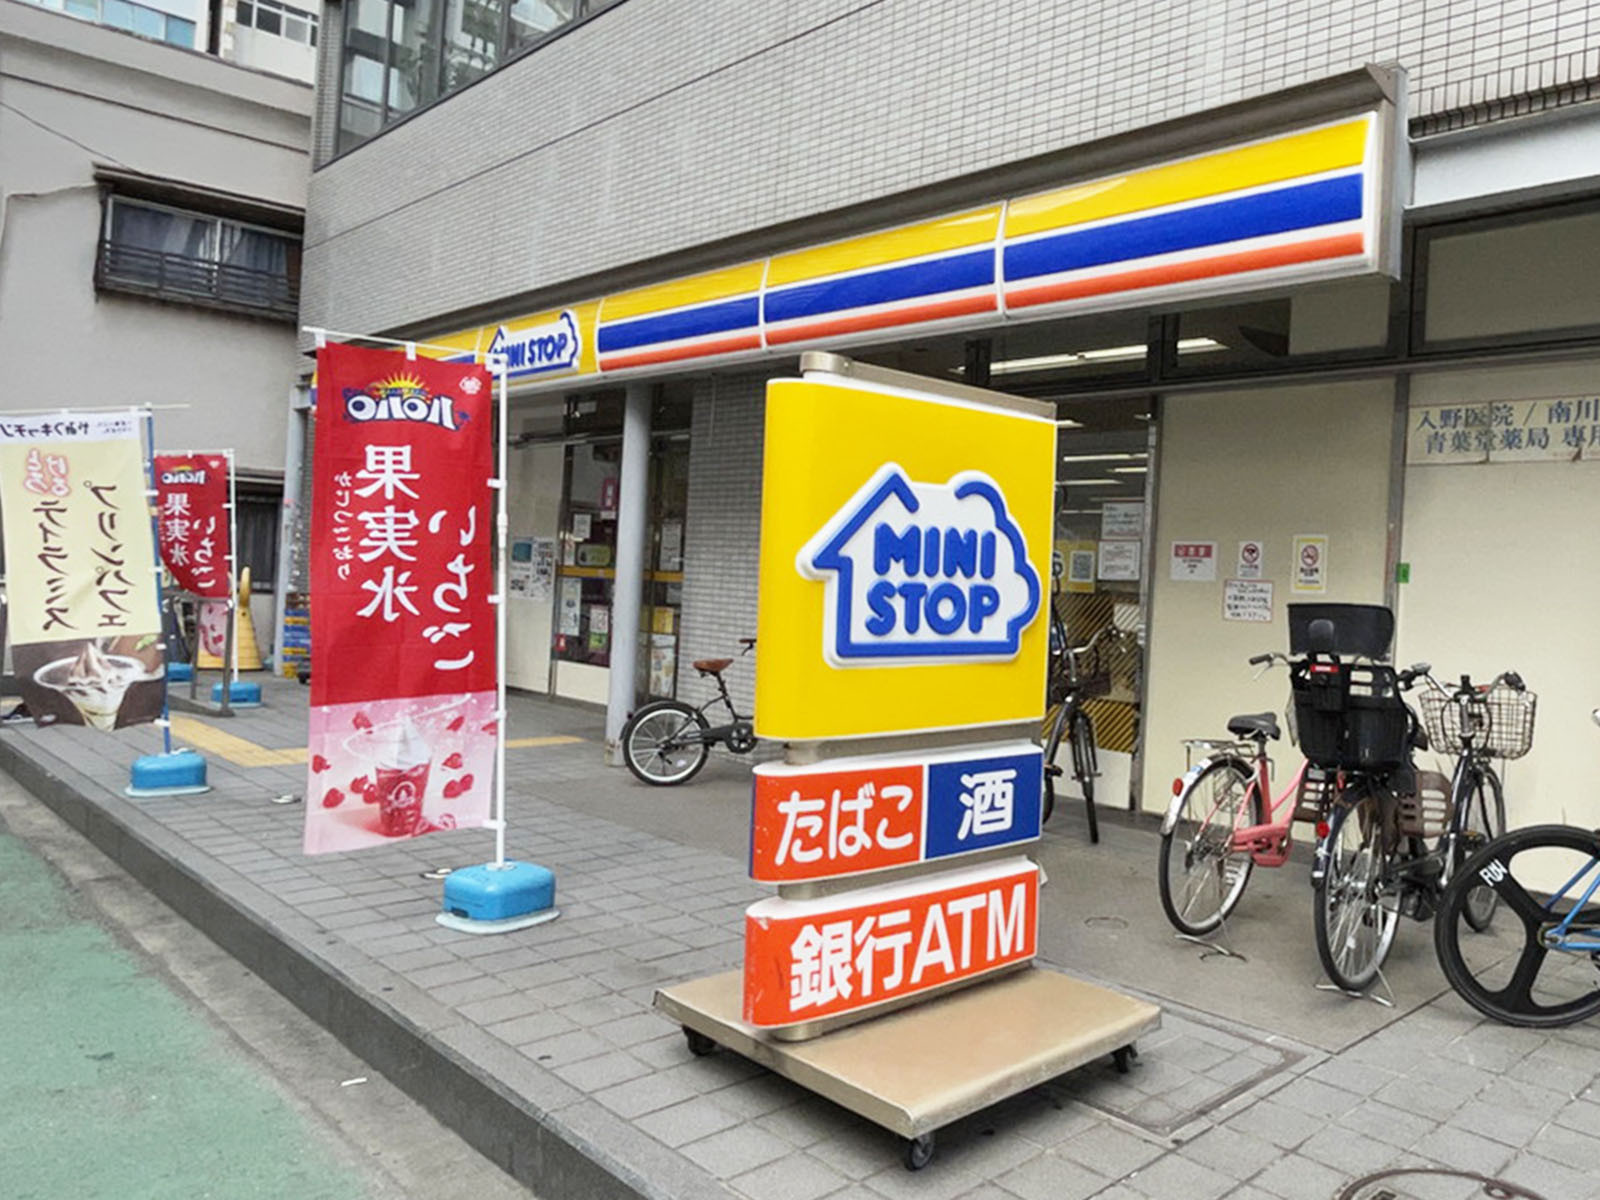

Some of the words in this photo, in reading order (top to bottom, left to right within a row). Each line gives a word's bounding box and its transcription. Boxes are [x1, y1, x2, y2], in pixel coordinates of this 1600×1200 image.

[494, 342, 525, 368] INI
[528, 332, 568, 365] STOP
[873, 522, 996, 579] MINI
[865, 580, 1000, 636] STOP
[774, 781, 914, 866] たばこ
[957, 769, 1017, 840] 酒
[790, 882, 1026, 1013] 銀行ATM
